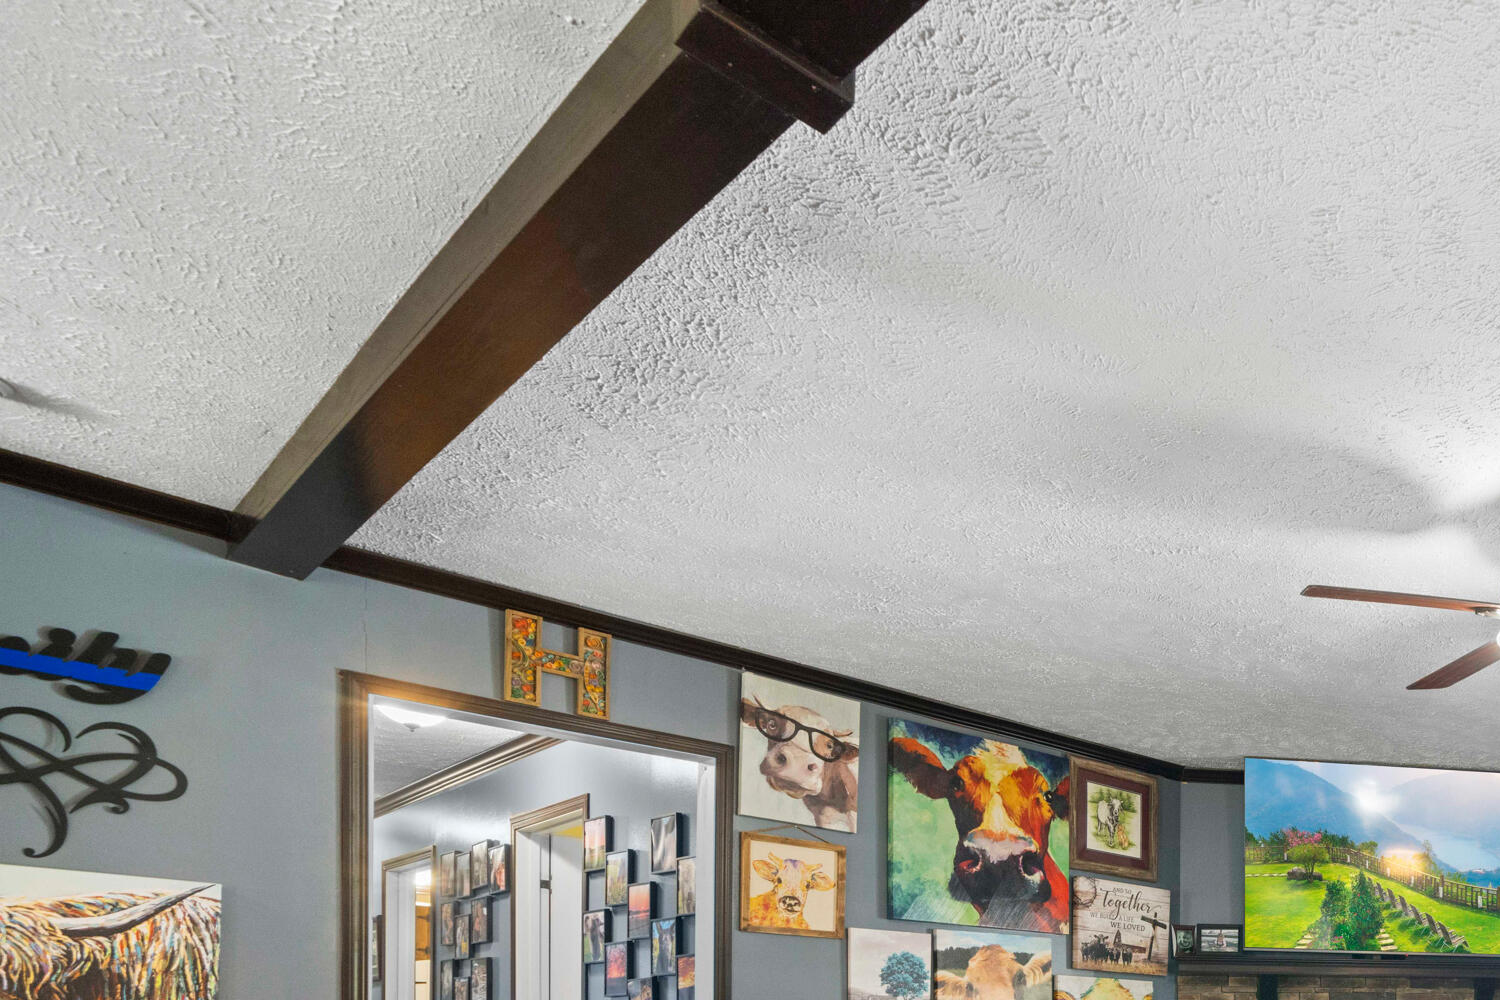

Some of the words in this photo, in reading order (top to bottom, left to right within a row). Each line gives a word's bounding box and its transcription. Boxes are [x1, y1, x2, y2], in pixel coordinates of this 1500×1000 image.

[504, 609, 612, 720] H
[1100, 888, 1160, 920] Together
[1123, 923, 1145, 931] LOVED
